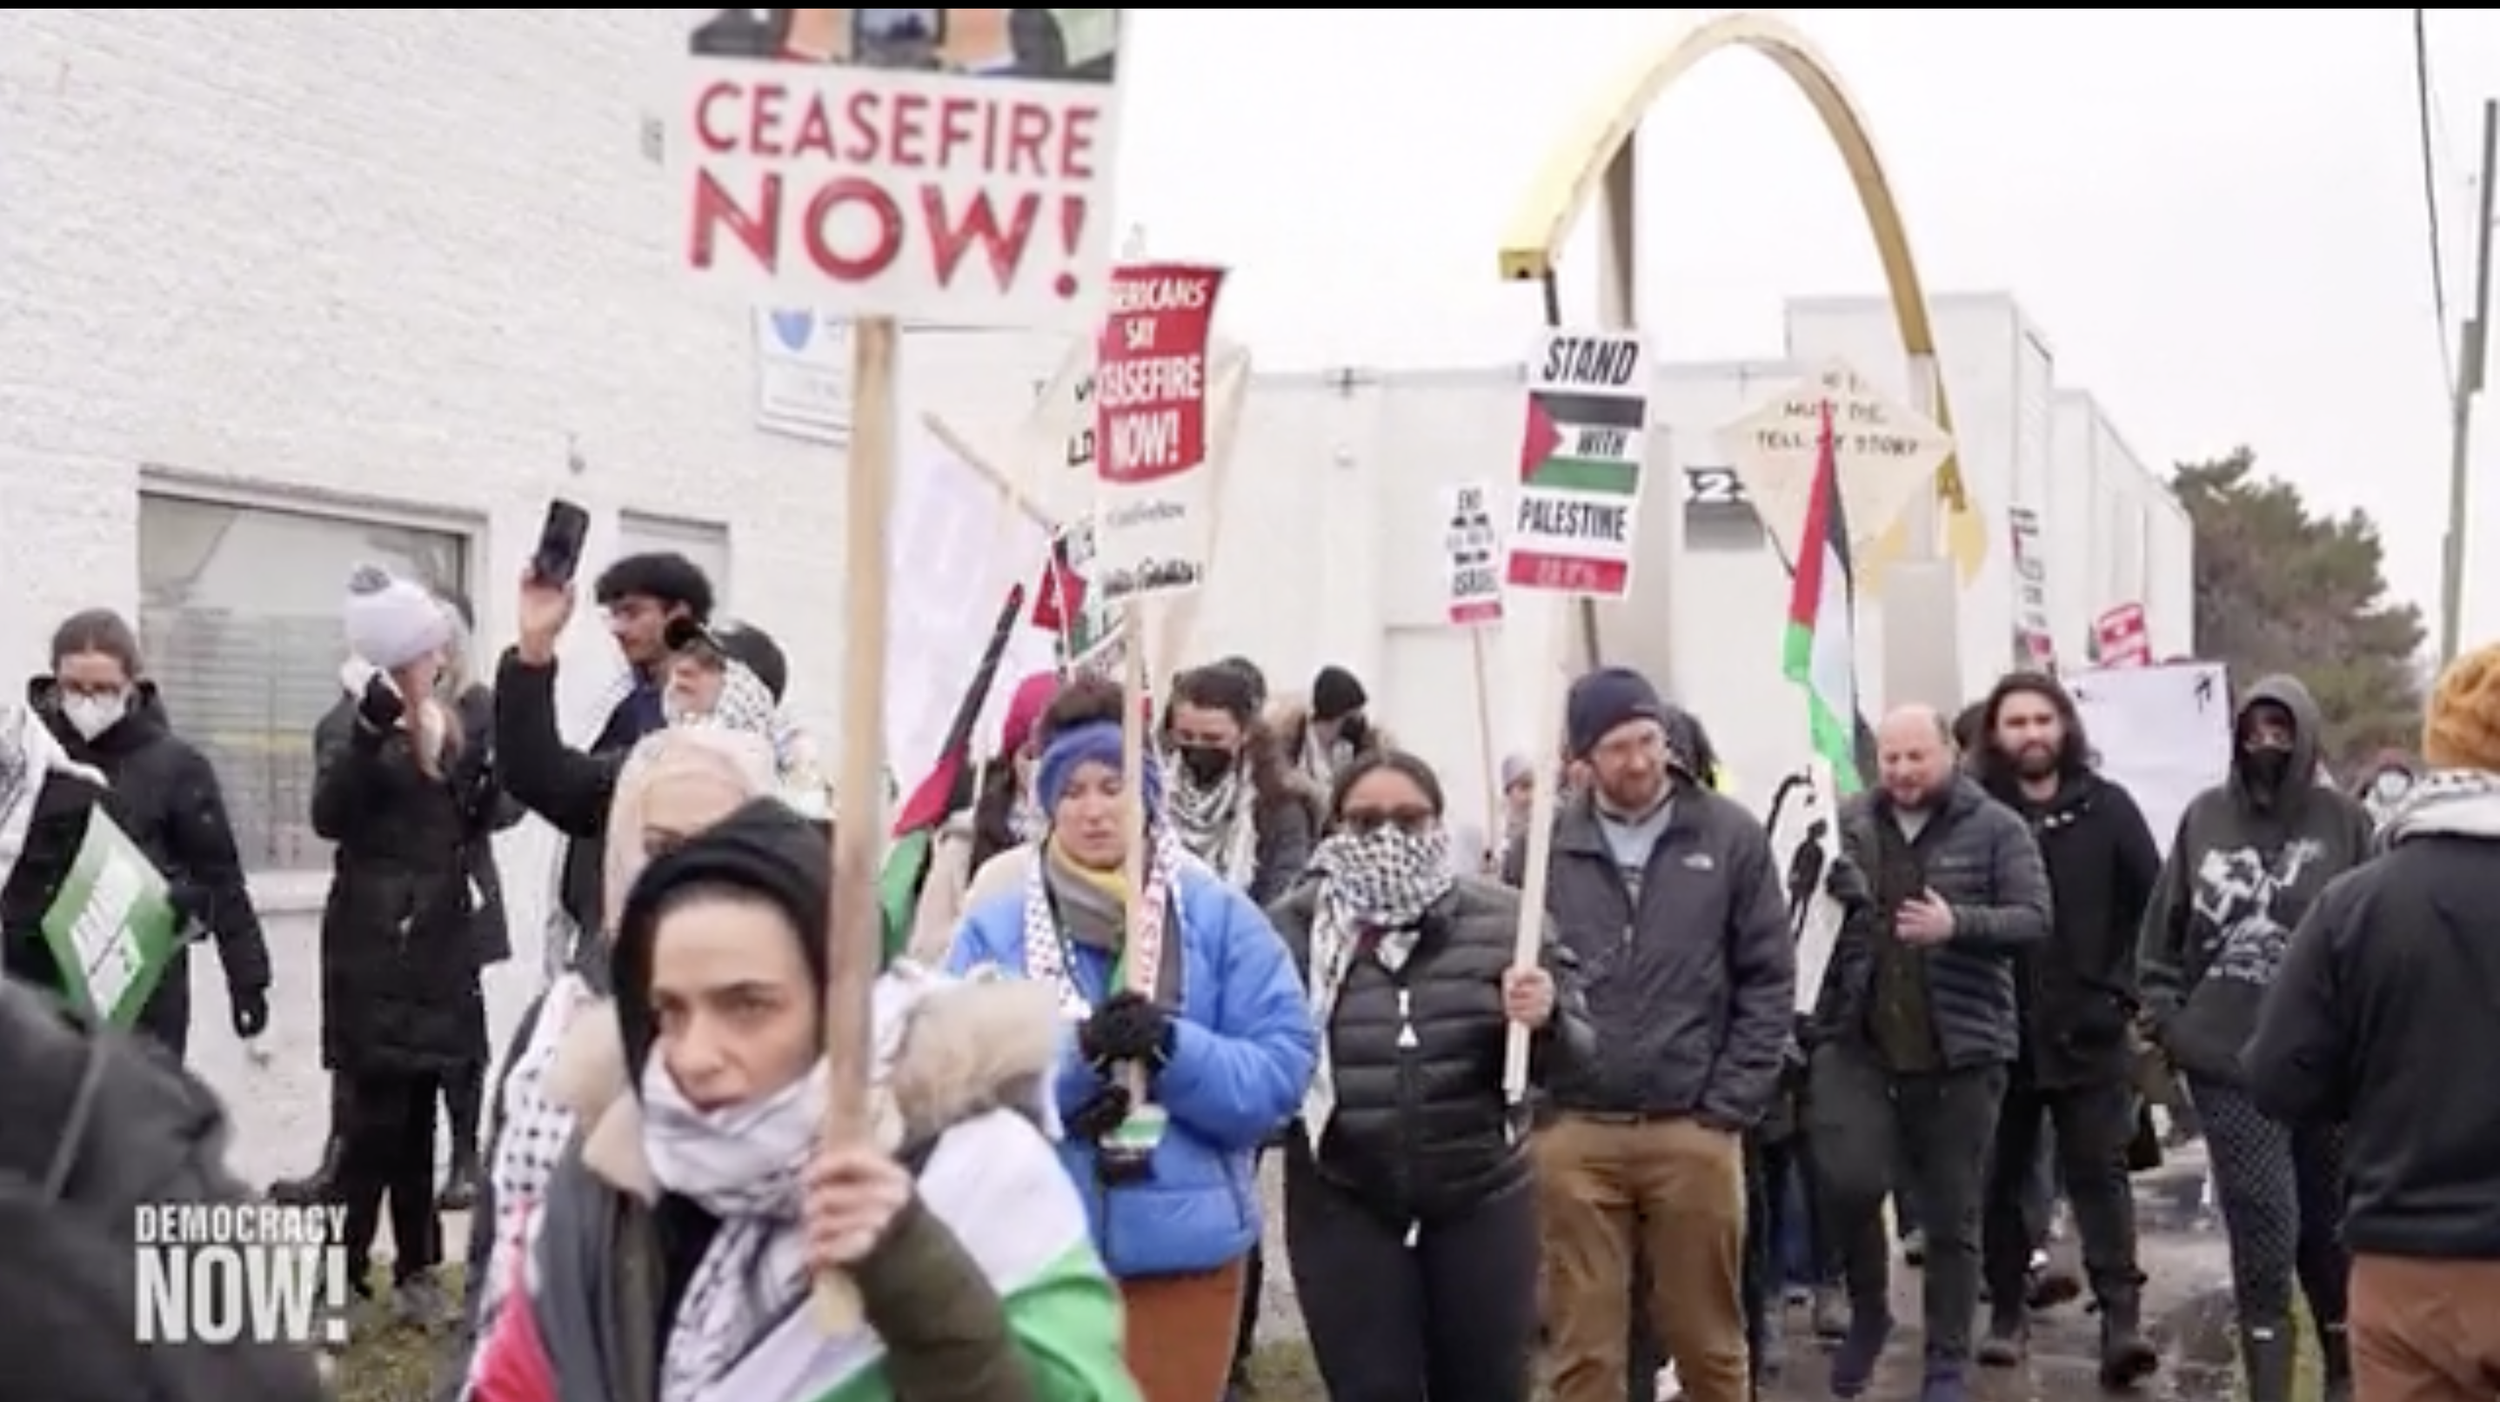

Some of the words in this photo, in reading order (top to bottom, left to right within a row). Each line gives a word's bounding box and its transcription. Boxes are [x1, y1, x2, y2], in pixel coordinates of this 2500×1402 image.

[694, 81, 1098, 180] CEASEFIRE
[690, 166, 1086, 299] NOW!
[1542, 336, 1640, 386] STAND
[1109, 408, 1180, 472] NOW!
[1576, 429, 1627, 457] WITH
[1517, 497, 1628, 542] PALESTINE
